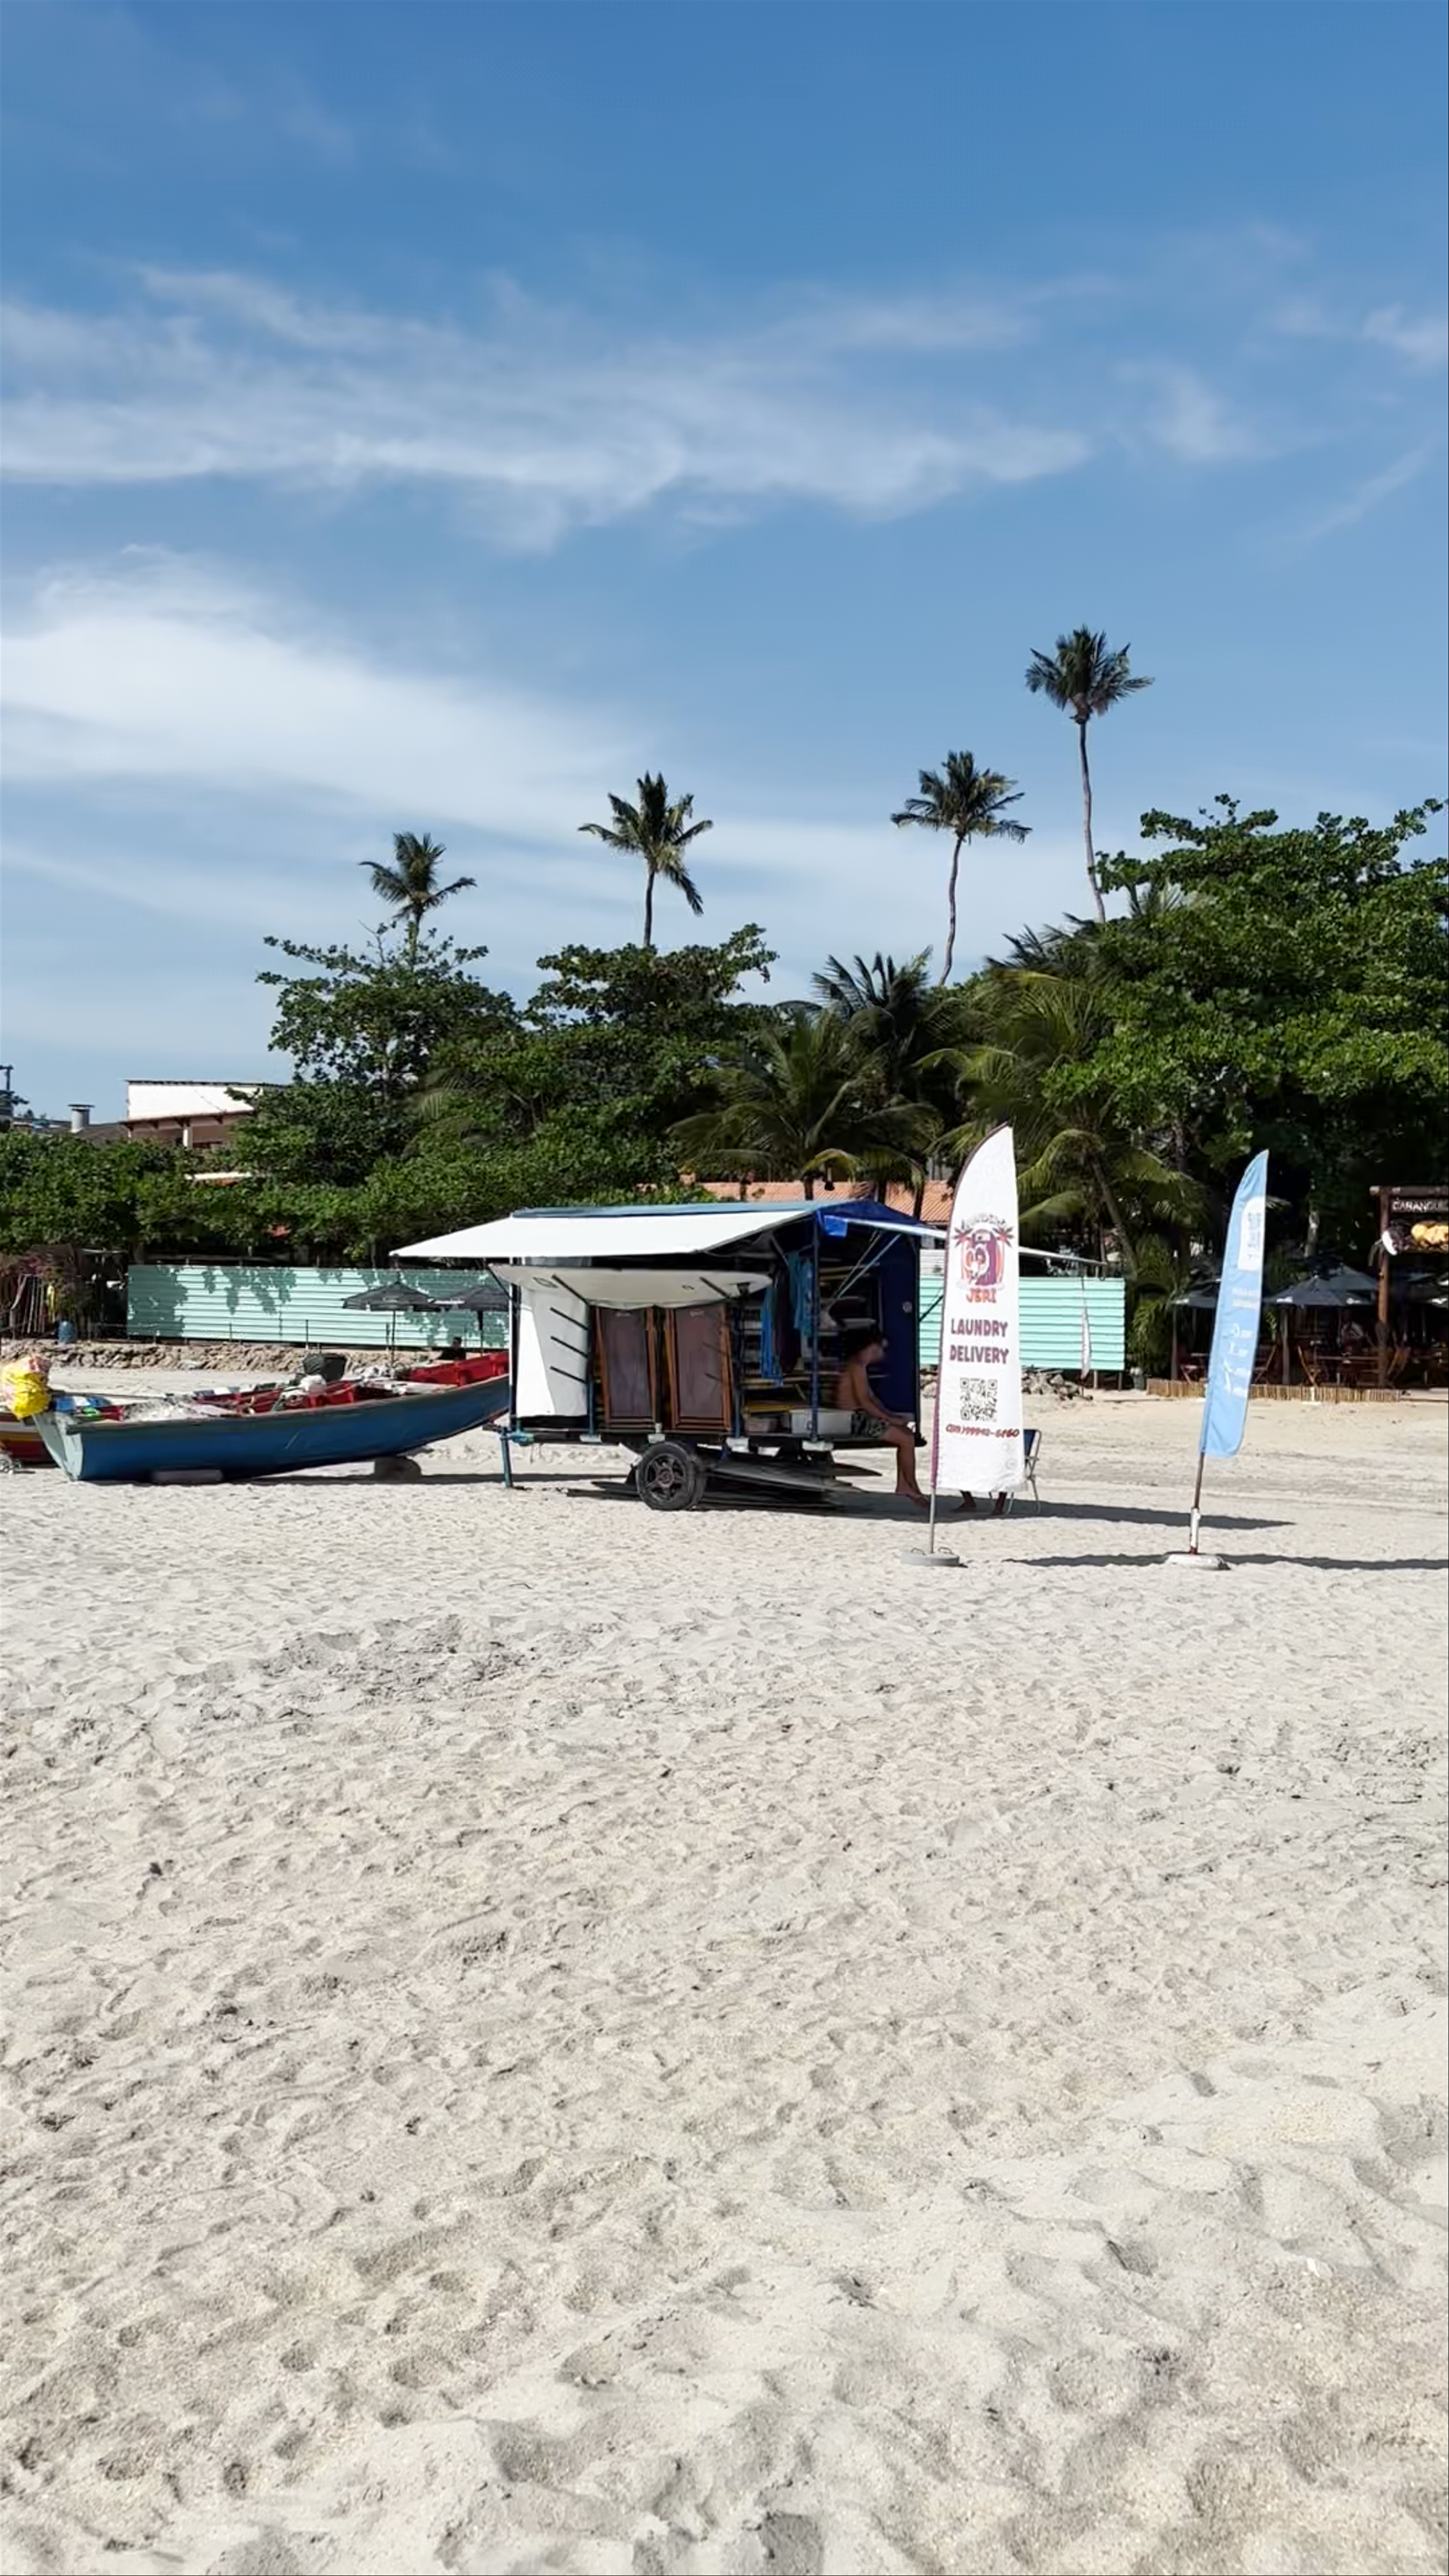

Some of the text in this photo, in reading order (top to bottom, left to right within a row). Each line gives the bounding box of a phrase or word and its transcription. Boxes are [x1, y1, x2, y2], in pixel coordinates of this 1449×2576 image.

[966, 1288, 997, 1303] JERI
[951, 1318, 1008, 1337] LAUNDRY
[949, 1344, 1009, 1364] DELIVERY
